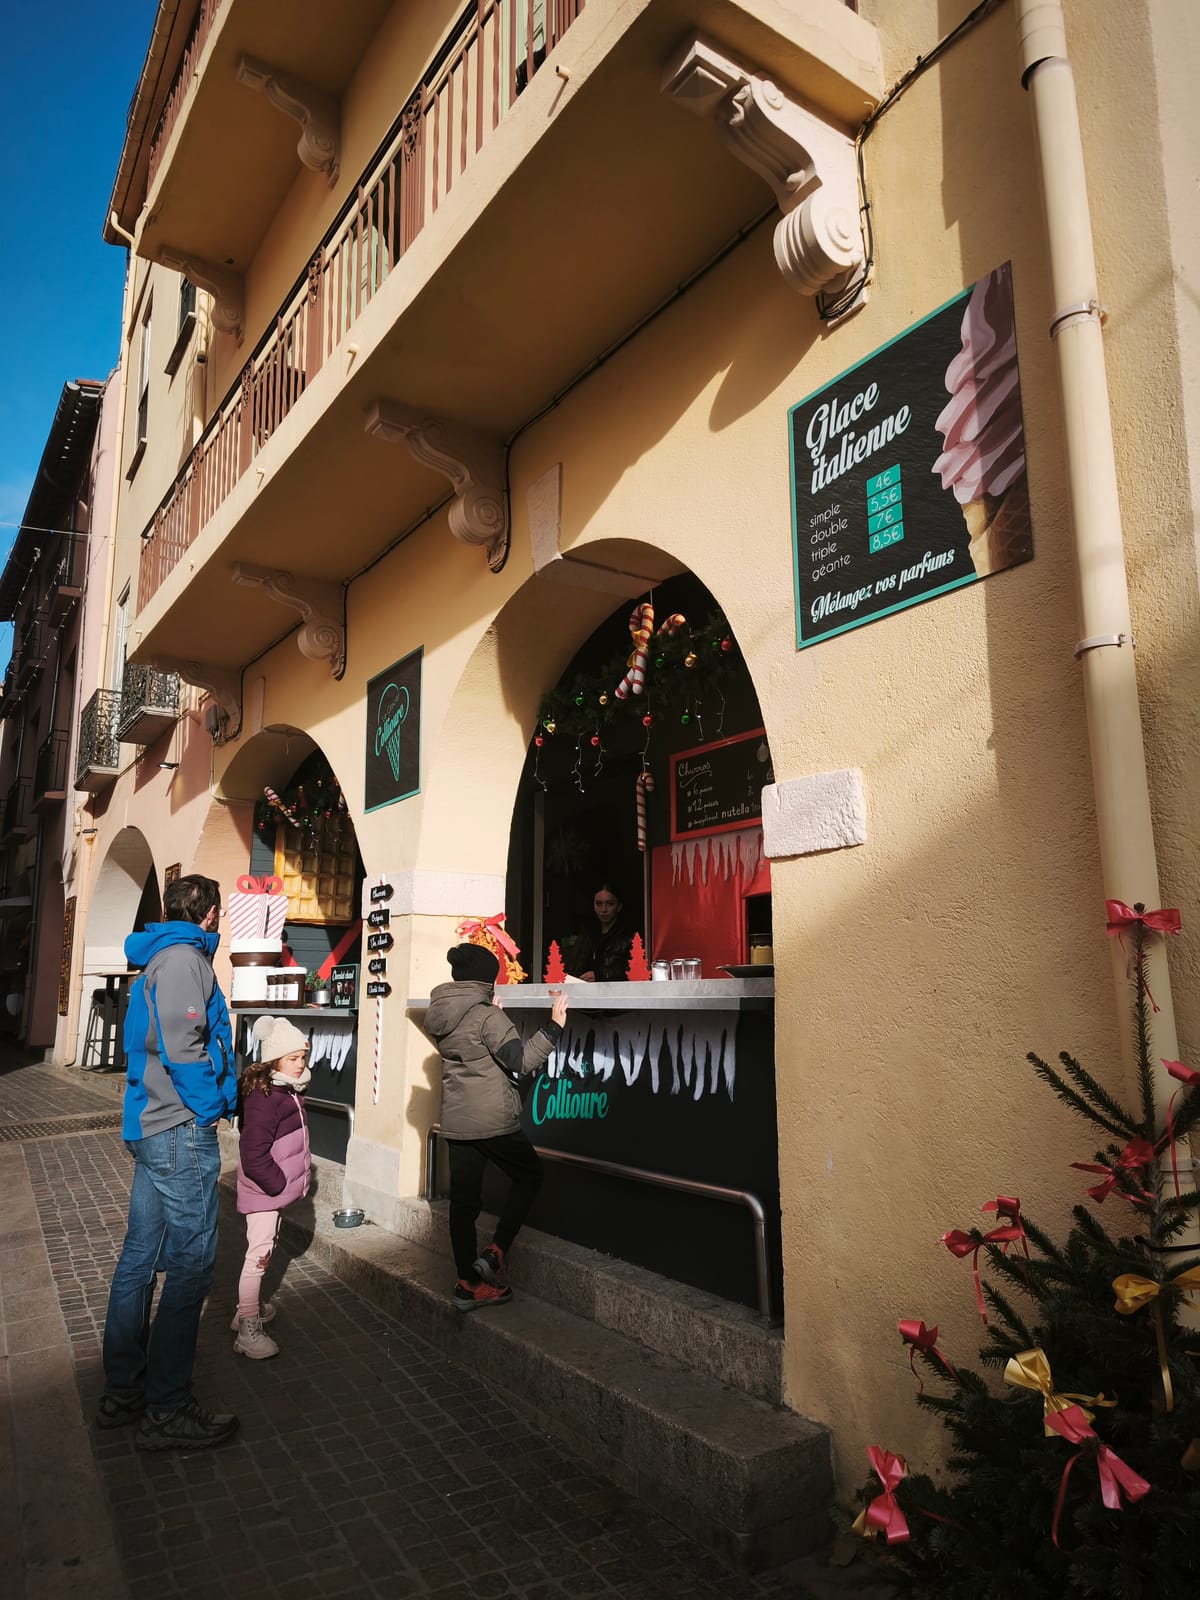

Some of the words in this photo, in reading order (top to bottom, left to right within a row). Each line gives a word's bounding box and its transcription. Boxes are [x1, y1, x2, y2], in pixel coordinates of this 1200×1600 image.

[805, 382, 880, 459] Glace
[811, 405, 912, 495] italienne
[809, 503, 841, 528] simple
[875, 471, 893, 489] 4€
[810, 518, 848, 544] double
[870, 487, 898, 512] 5,5€
[811, 542, 837, 563] triple
[876, 508, 894, 529] 7€
[811, 554, 850, 581] géante
[872, 525, 901, 550] 8,5€
[811, 584, 872, 623] Mélangez
[875, 574, 897, 595] vos
[898, 548, 955, 591] parfums
[375, 705, 404, 756] Collioure
[678, 761, 711, 777] Churros
[721, 803, 750, 819] nutella
[532, 1073, 609, 1125] Collioure
